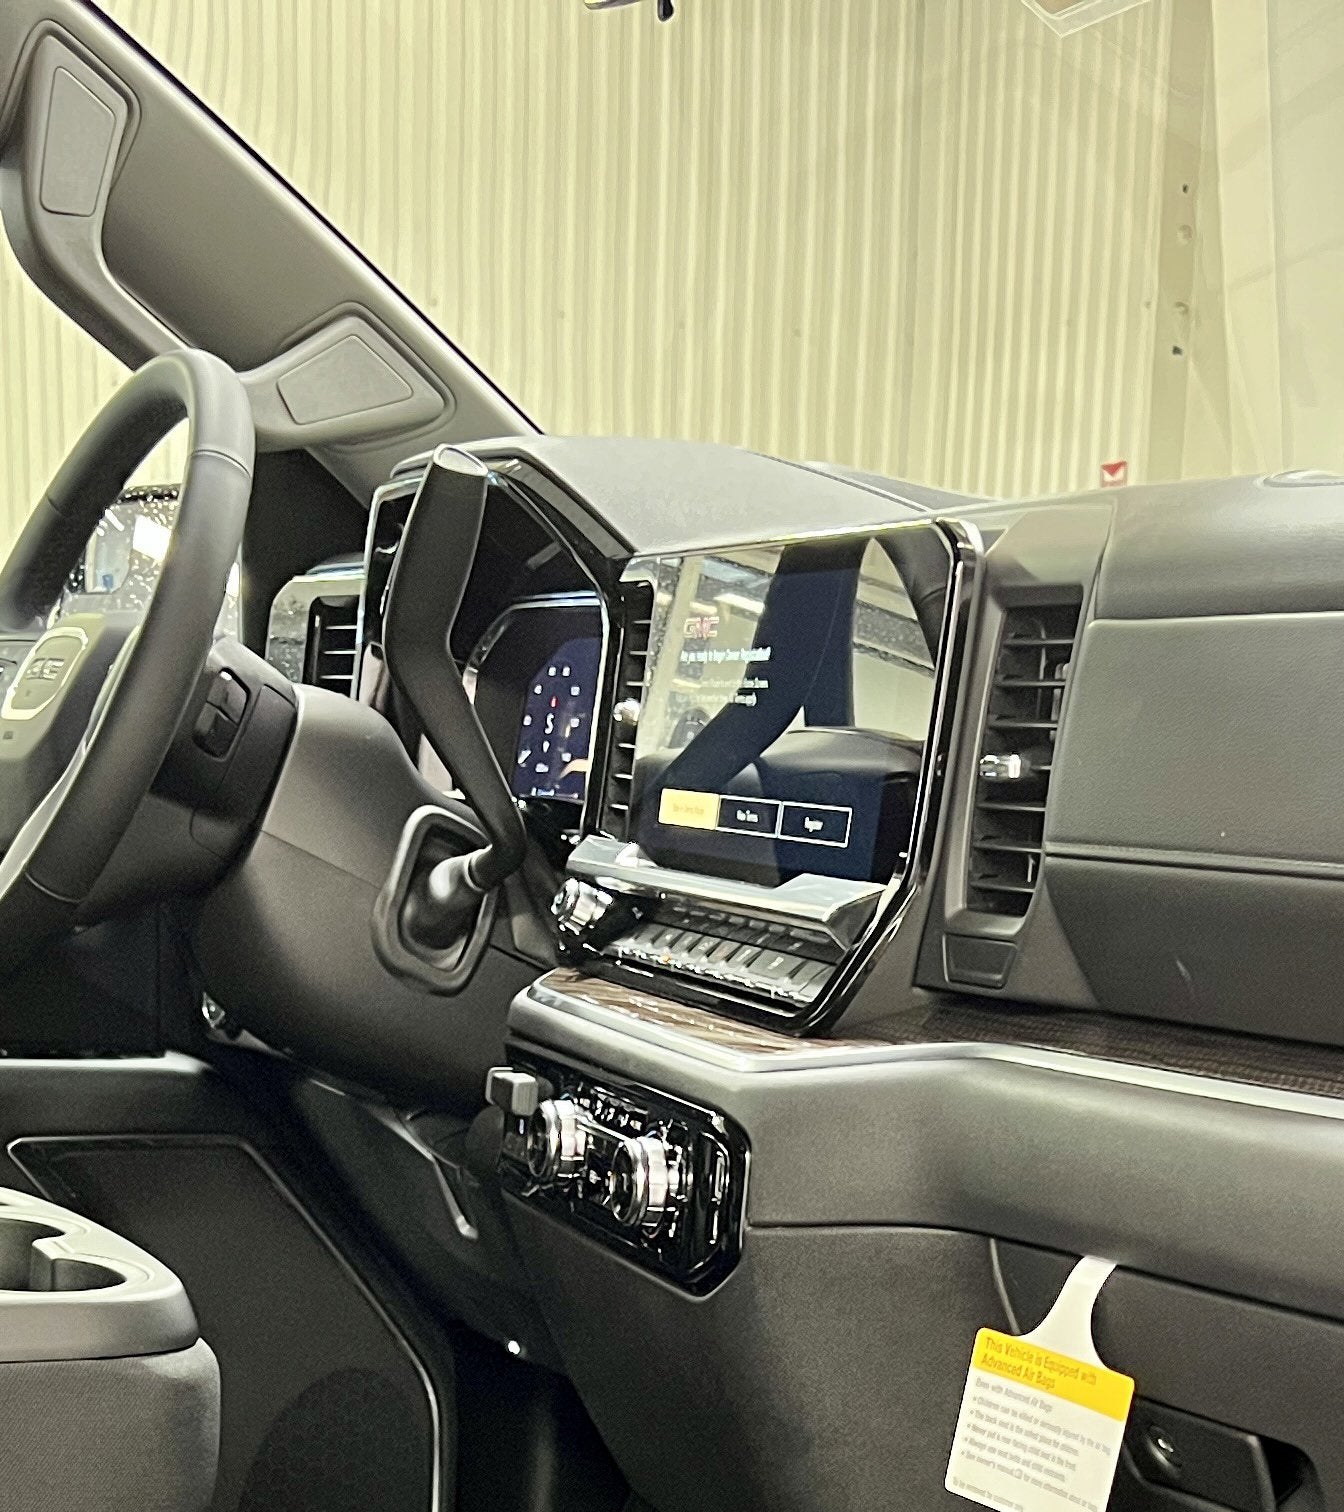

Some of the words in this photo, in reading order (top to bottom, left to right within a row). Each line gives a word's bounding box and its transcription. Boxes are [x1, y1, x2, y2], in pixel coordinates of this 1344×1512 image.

[985, 1337, 1003, 1353] This
[1005, 1342, 1033, 1363] Vehicle
[981, 1353, 1022, 1377] Advanced
[1023, 1368, 1036, 1381] Air
[1036, 1371, 1056, 1390] Bags
